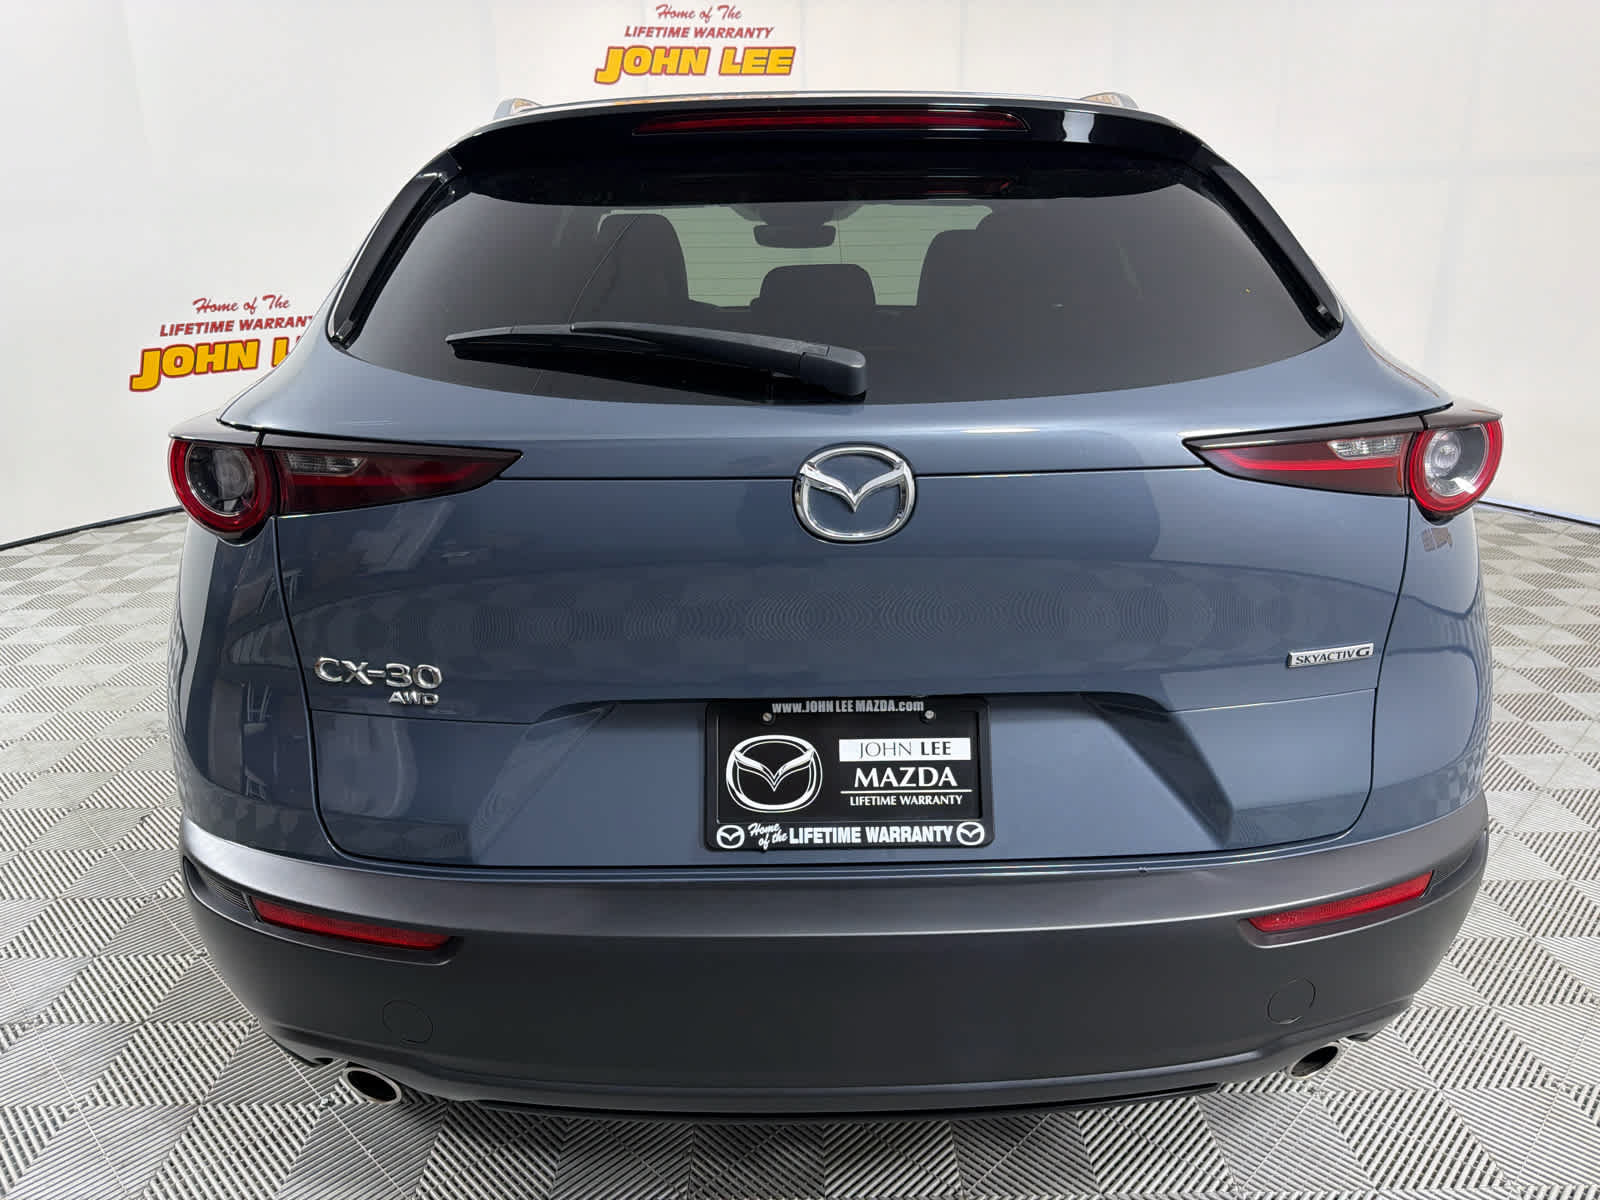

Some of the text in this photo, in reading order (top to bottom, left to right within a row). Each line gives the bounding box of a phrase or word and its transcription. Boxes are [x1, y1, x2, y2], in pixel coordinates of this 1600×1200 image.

[655, 4, 742, 23] Home of The
[624, 25, 774, 39] LIFETIME WARRANTY
[594, 44, 796, 85] JOHN LEE
[192, 294, 289, 315] Home of The
[159, 315, 312, 337] LIFETIME WARRAN
[129, 338, 260, 392] JOHN
[314, 656, 442, 689] CX-30
[388, 690, 439, 705] AWD
[772, 699, 924, 713] www.JOHN LEE MAZDA.com
[859, 741, 952, 757] JOHN LEE
[854, 766, 958, 788] MAZDA
[850, 795, 963, 806] LIFETIME WARRANTY
[747, 822, 781, 837] Home
[789, 825, 954, 844] LIFETIME WARRANTY
[758, 829, 788, 850] of the
